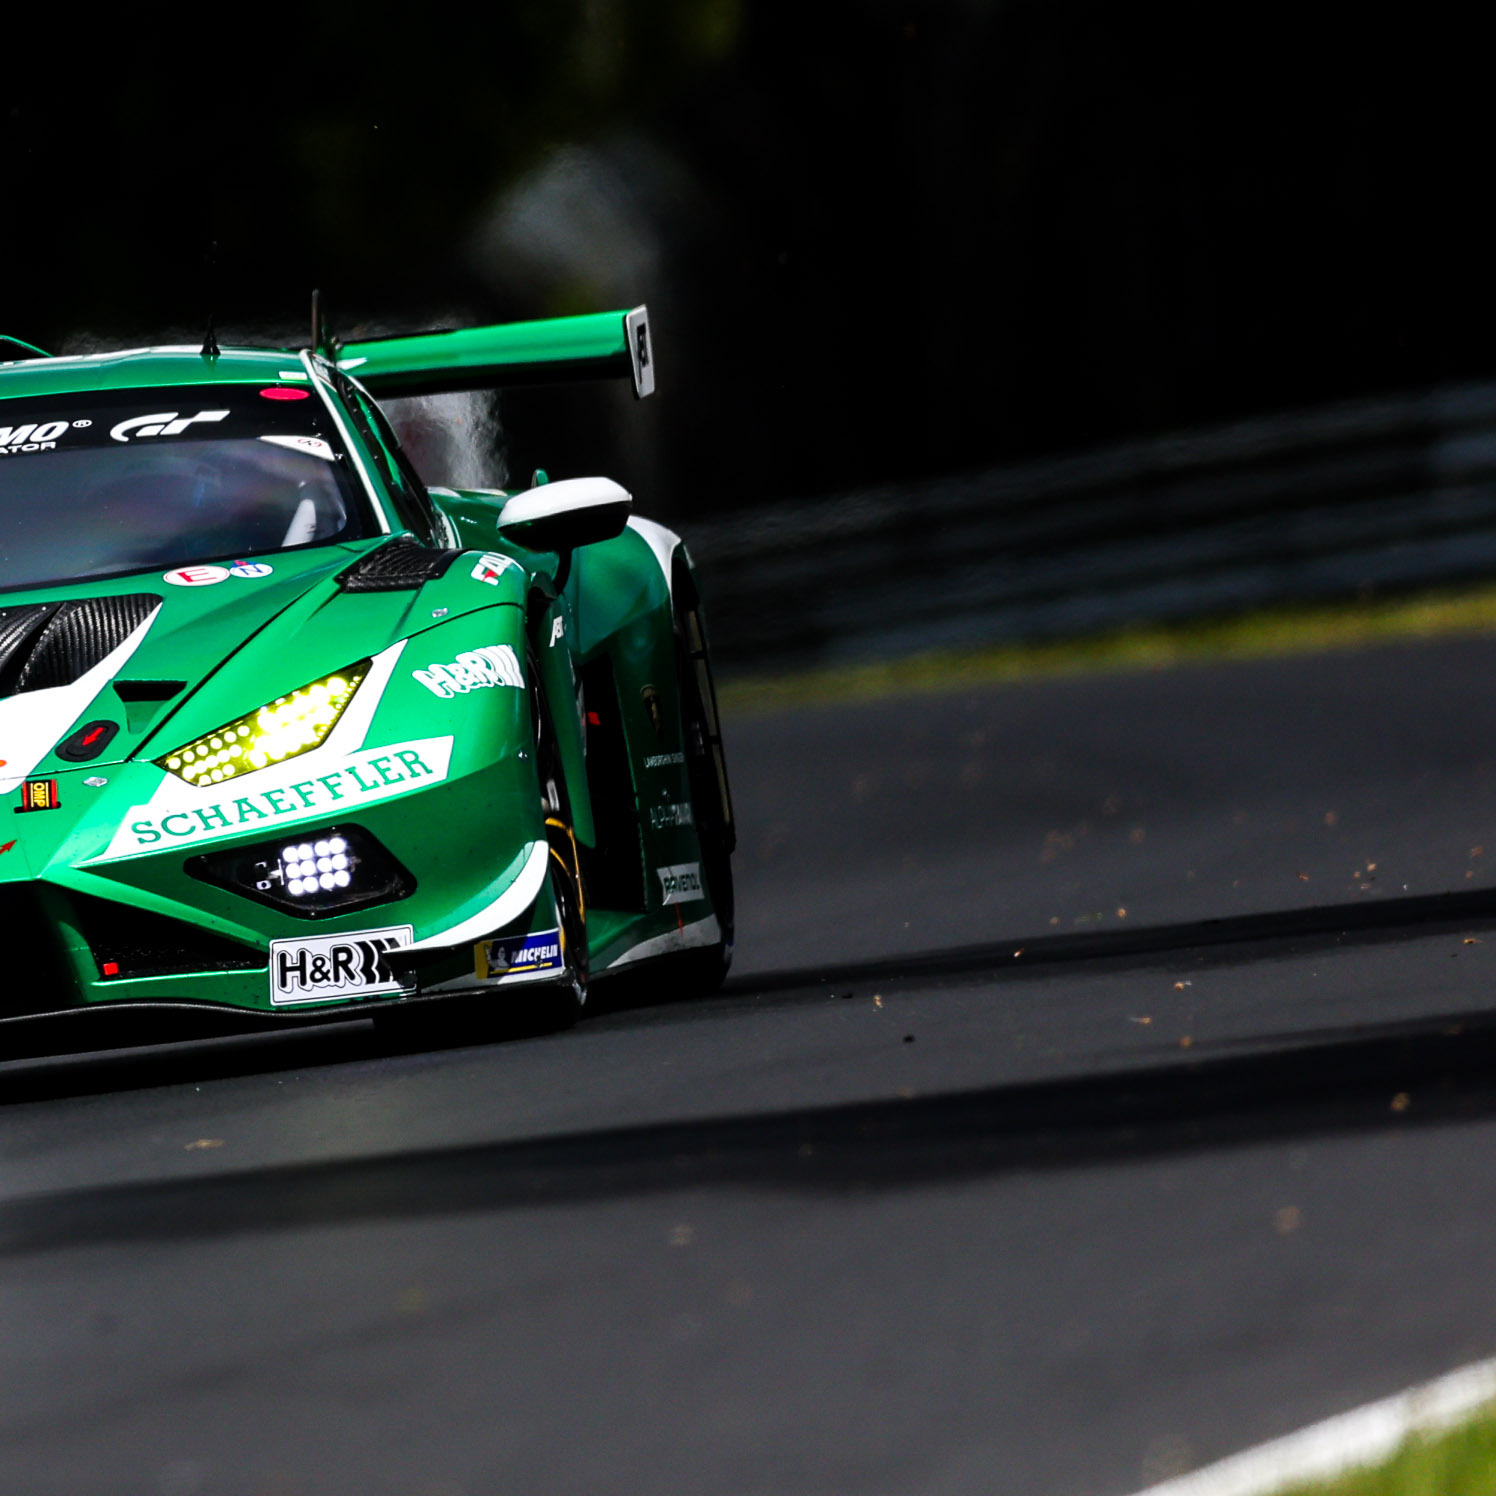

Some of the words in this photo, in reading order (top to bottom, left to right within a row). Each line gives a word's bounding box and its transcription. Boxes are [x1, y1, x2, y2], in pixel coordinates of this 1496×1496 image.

[33, 782, 46, 807] OMP
[132, 748, 434, 844] SCHAEFFLER
[277, 944, 360, 992] H&R
[511, 944, 558, 963] MICHELIN
